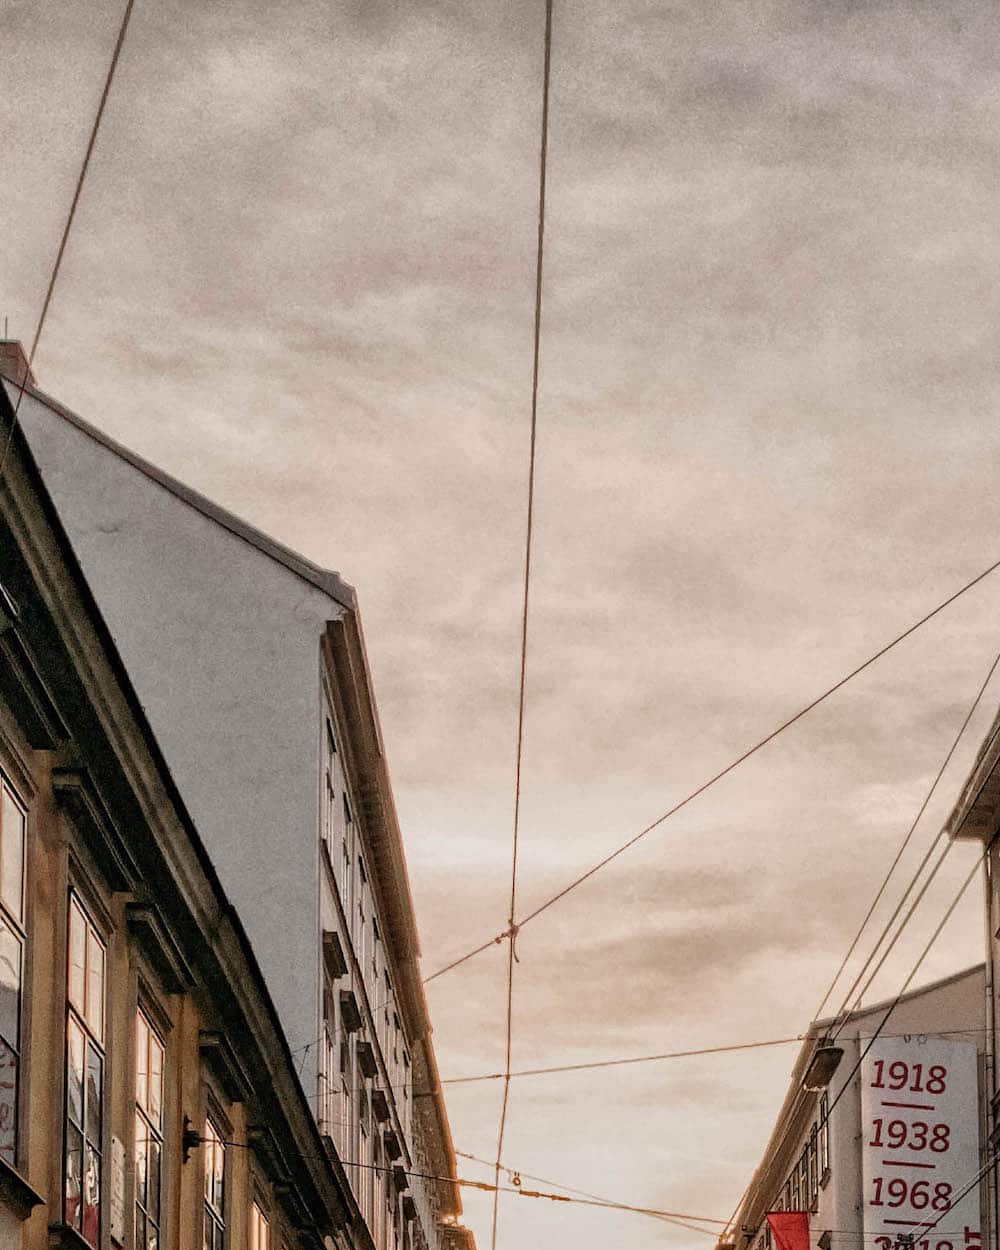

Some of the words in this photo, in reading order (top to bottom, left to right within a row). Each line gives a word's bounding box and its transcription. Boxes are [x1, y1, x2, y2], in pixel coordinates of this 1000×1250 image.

[871, 1060, 947, 1094] 1918
[869, 1119, 950, 1153] 1938
[869, 1177, 953, 1212] 1968
